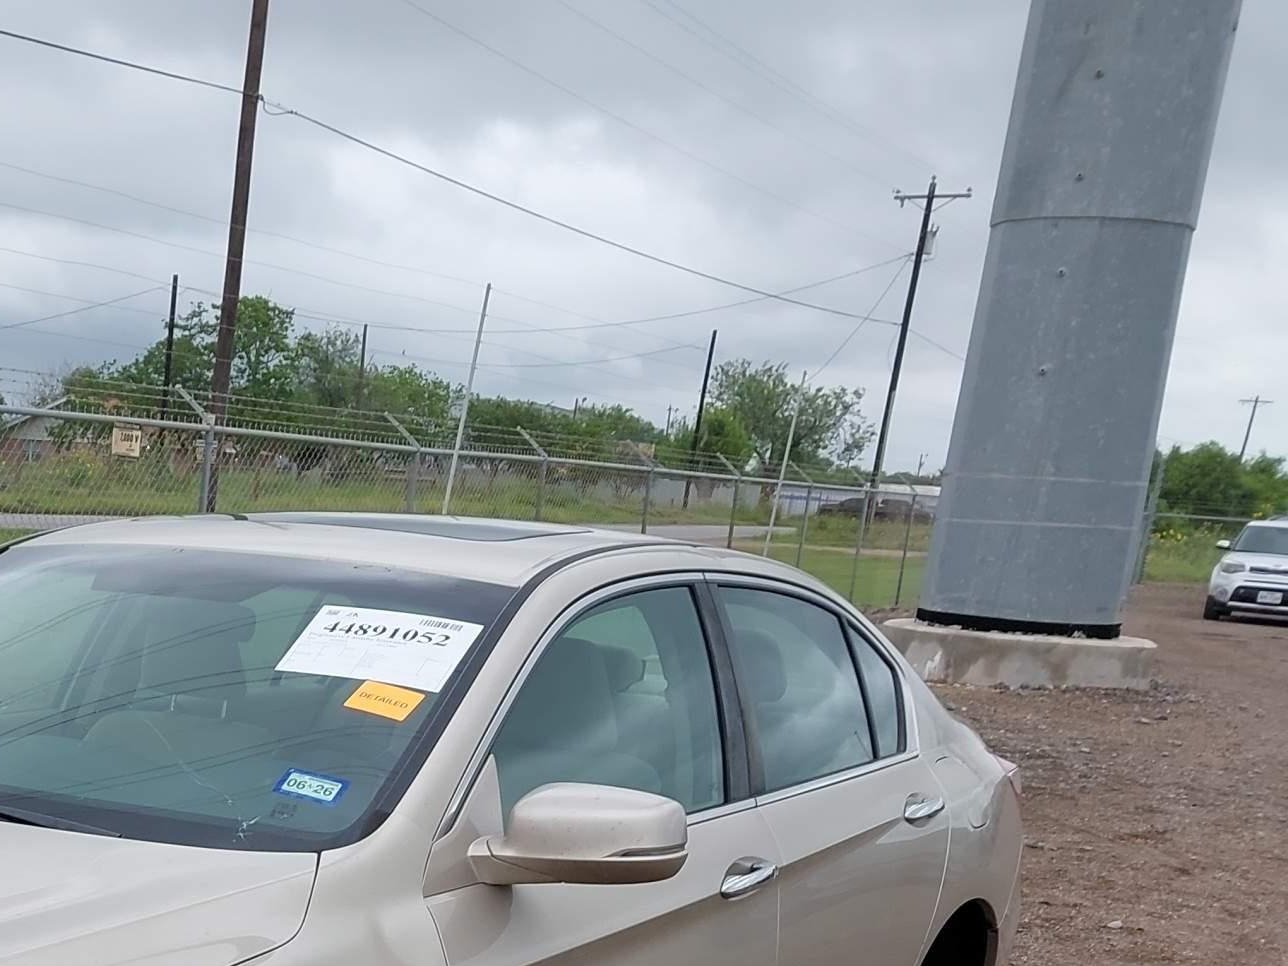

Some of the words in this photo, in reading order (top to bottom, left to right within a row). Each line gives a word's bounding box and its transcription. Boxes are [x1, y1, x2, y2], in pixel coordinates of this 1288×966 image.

[322, 620, 452, 648] 44891052
[359, 691, 409, 709] DETAILED
[286, 778, 307, 790] 06
[312, 784, 335, 797] 26
